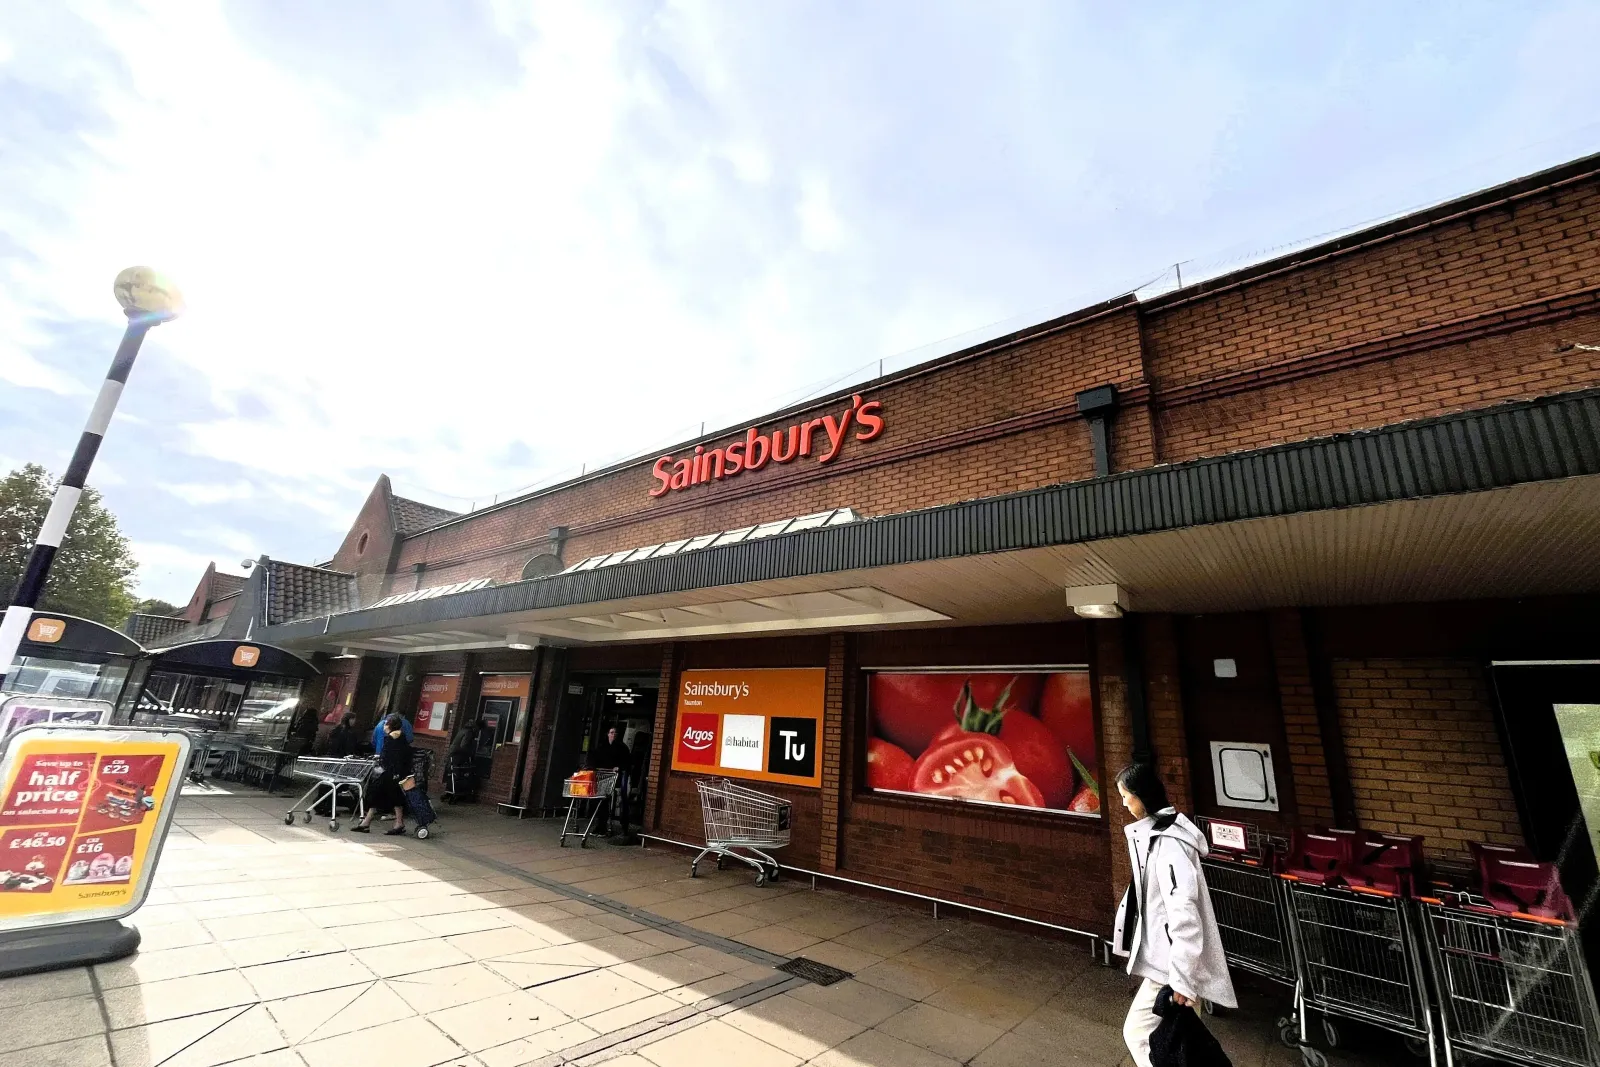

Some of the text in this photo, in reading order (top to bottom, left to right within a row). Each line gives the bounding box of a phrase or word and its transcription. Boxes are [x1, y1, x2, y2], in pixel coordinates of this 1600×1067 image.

[649, 392, 885, 497] Sainsbury's
[684, 681, 749, 699] Sainsbury's
[683, 726, 714, 744] Argos
[732, 736, 759, 749] habitat
[779, 730, 806, 761] Tu
[102, 765, 130, 774] £23
[28, 770, 81, 786] half
[14, 786, 79, 806] price
[9, 836, 67, 849] £46.50
[76, 843, 104, 854] £16
[78, 888, 127, 899] Sainsbury's
